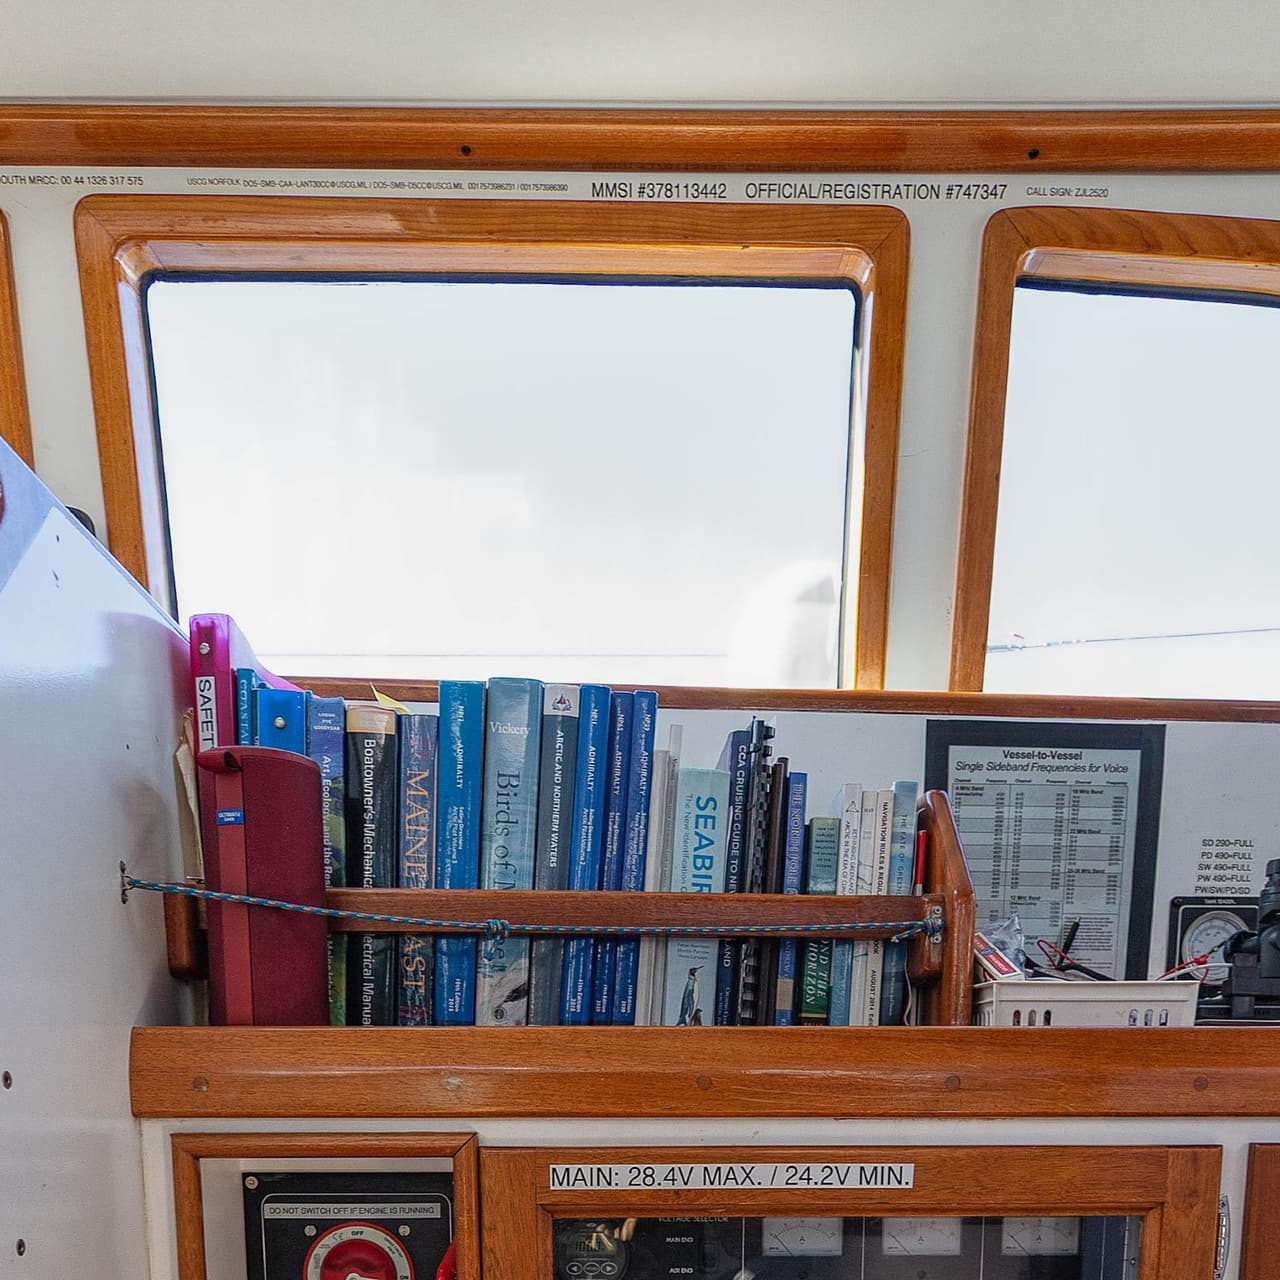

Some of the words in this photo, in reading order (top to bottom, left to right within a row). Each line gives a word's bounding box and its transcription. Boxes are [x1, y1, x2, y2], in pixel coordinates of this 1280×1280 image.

[29, 175, 59, 185] MRCC:
[61, 176, 71, 185] 00
[74, 176, 84, 185] 44
[87, 176, 107, 185] 1326
[110, 176, 126, 186] 317
[128, 176, 143, 186] 575
[592, 183, 632, 198] MMSI
[638, 183, 727, 199] #378113442
[745, 183, 940, 200] OFFICIAL/REGISTRATION
[946, 184, 1007, 200] #747347
[1026, 186, 1048, 196] CALL
[199, 679, 214, 752] SAFET
[490, 721, 530, 736] Vickery
[555, 731, 564, 762] ARCTIC
[737, 745, 746, 767] CCA
[1002, 750, 1083, 760] Vessel-to-Vessel
[554, 763, 563, 783] AND
[955, 761, 984, 773] Single
[986, 761, 1030, 771] Sideband
[1030, 762, 1087, 774] Frequencies
[1087, 763, 1101, 773] for
[1104, 763, 1128, 774] Voice
[363, 739, 376, 820] Boatowner's
[494, 771, 520, 836] Birds
[684, 794, 693, 809] The
[734, 770, 745, 820] CRUISING
[550, 785, 562, 831] NORTHERN
[404, 768, 429, 878] MAINE
[683, 811, 692, 829] New
[880, 802, 889, 842] NAVIGATION
[732, 823, 741, 856] GUIDE
[1202, 839, 1214, 848] SD
[363, 824, 375, 888] Mechanica
[494, 846, 520, 869] of
[549, 833, 559, 868] WATERS
[681, 831, 691, 884] Identification
[1201, 852, 1213, 860] PD
[731, 859, 739, 872] TO
[1199, 864, 1212, 872] SW
[1197, 875, 1211, 883] PW
[1195, 886, 1250, 895] PW/SW/PD/SD
[806, 943, 819, 1005] HORIZON
[551, 1167, 620, 1188] MAIN:
[628, 1166, 694, 1187] 28.4V
[703, 1166, 761, 1187] MAX.
[770, 1166, 778, 1186] /
[785, 1166, 850, 1186] 24.2V
[859, 1165, 910, 1186] MIN.
[269, 1207, 281, 1215] DO
[282, 1207, 299, 1215] NOT
[300, 1207, 331, 1215] SWITCH
[332, 1207, 348, 1215] OFF
